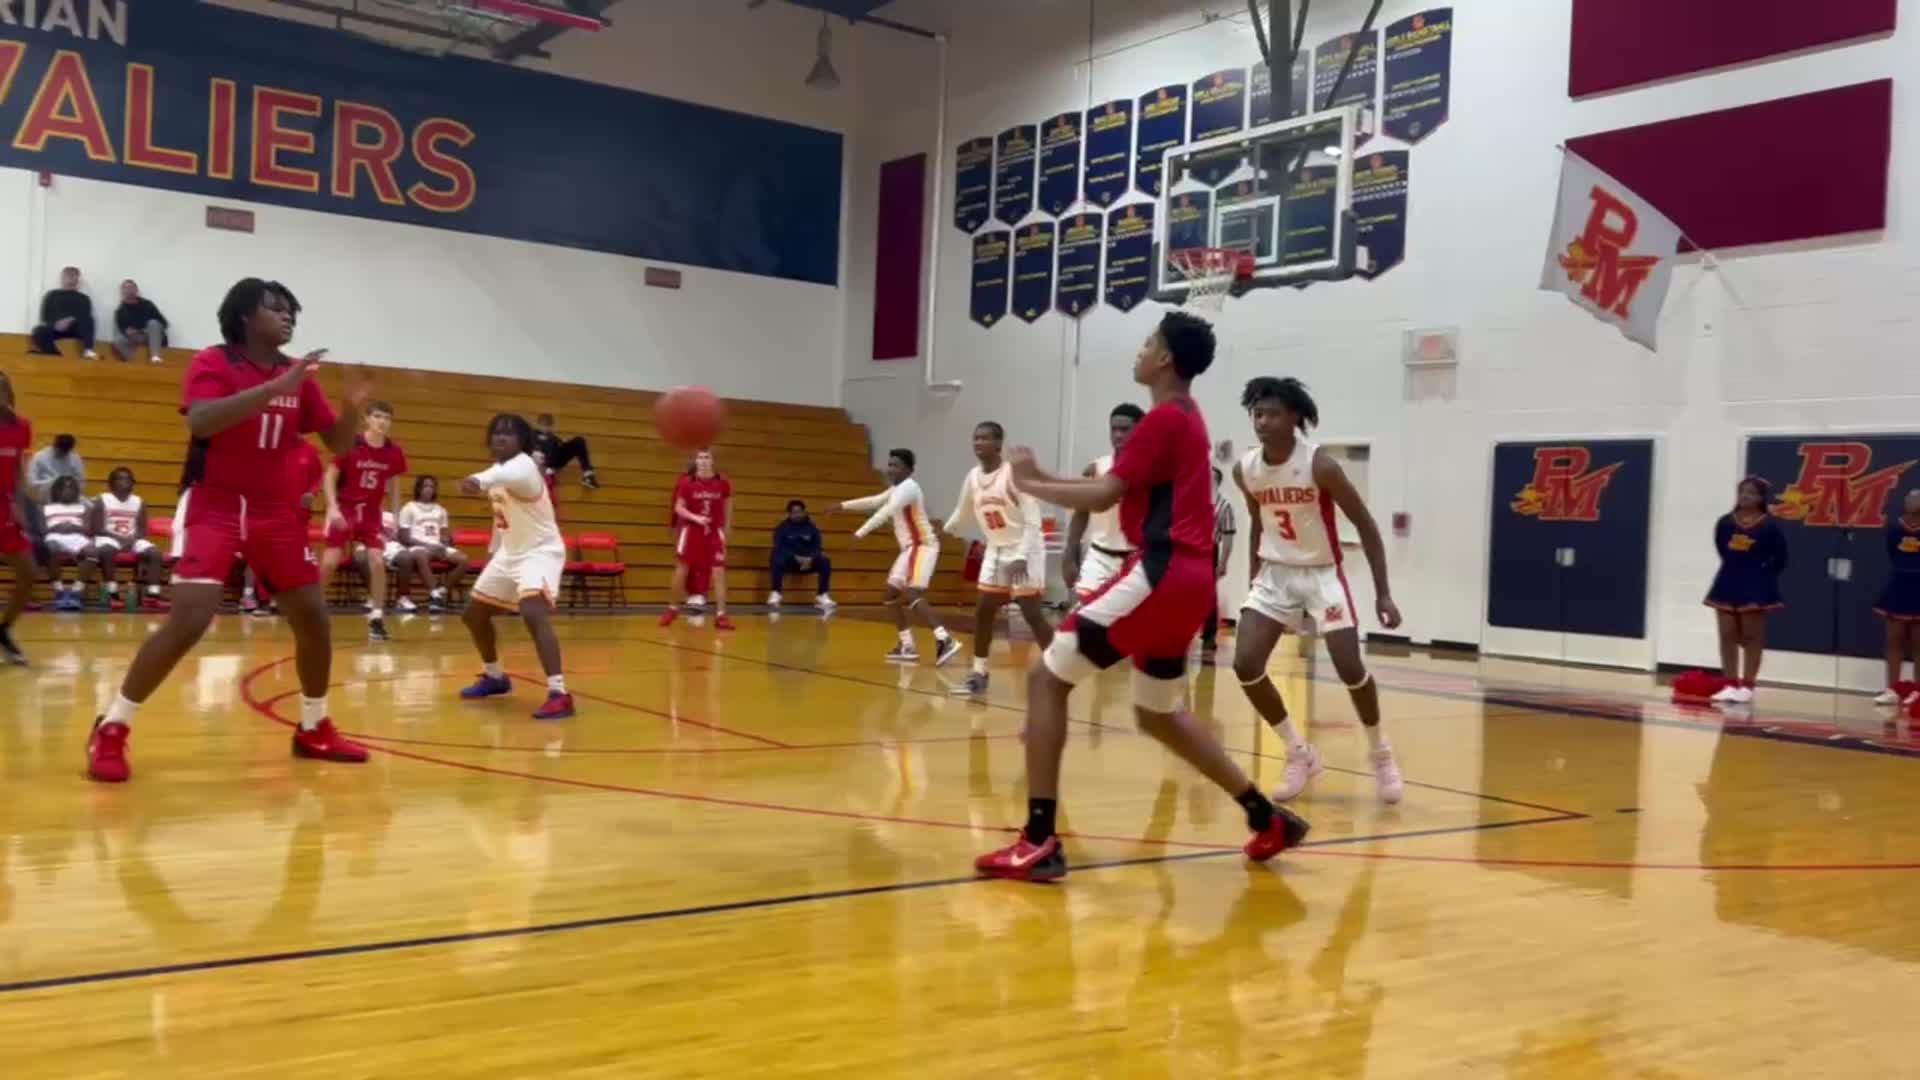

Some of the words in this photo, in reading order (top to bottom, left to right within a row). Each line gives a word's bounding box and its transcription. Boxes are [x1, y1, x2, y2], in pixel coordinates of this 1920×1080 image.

[258, 412, 284, 450] 11
[359, 469, 379, 489] 15
[1273, 509, 1297, 541] 3
